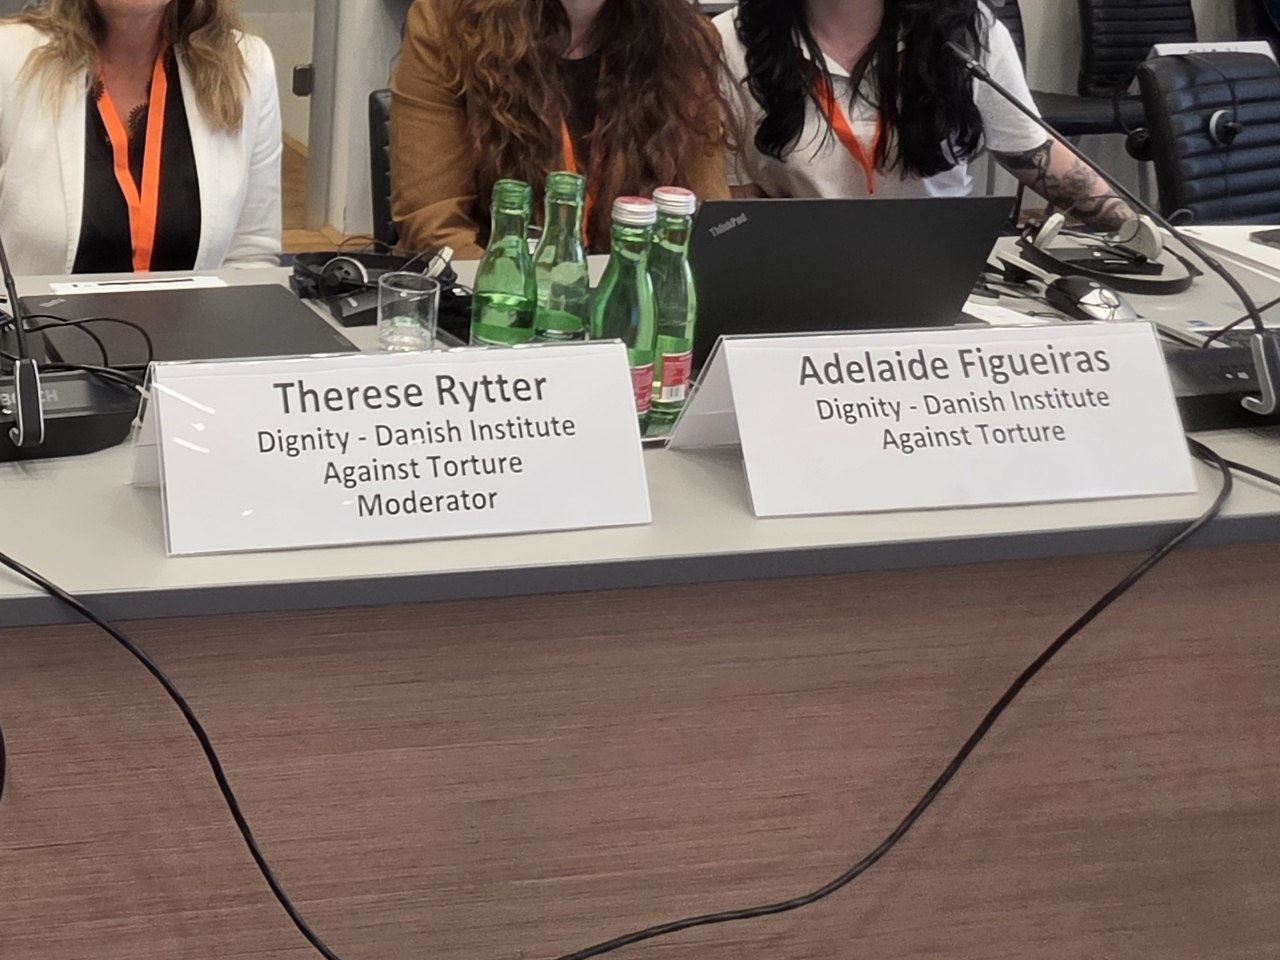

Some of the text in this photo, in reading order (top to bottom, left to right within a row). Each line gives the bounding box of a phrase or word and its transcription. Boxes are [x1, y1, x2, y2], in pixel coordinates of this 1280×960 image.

[799, 344, 1111, 386] Adelaide Figueiras
[273, 373, 547, 414] Therese Rytter
[816, 396, 901, 424] Dignity
[923, 390, 1006, 415] Danish
[1011, 387, 1111, 411] Institute
[257, 427, 350, 457] Dignity
[375, 419, 462, 446] Danish
[470, 416, 576, 441] Institute
[882, 423, 1066, 454] Against Torture
[323, 454, 523, 488] Against Torture
[357, 489, 498, 517] Moderator
